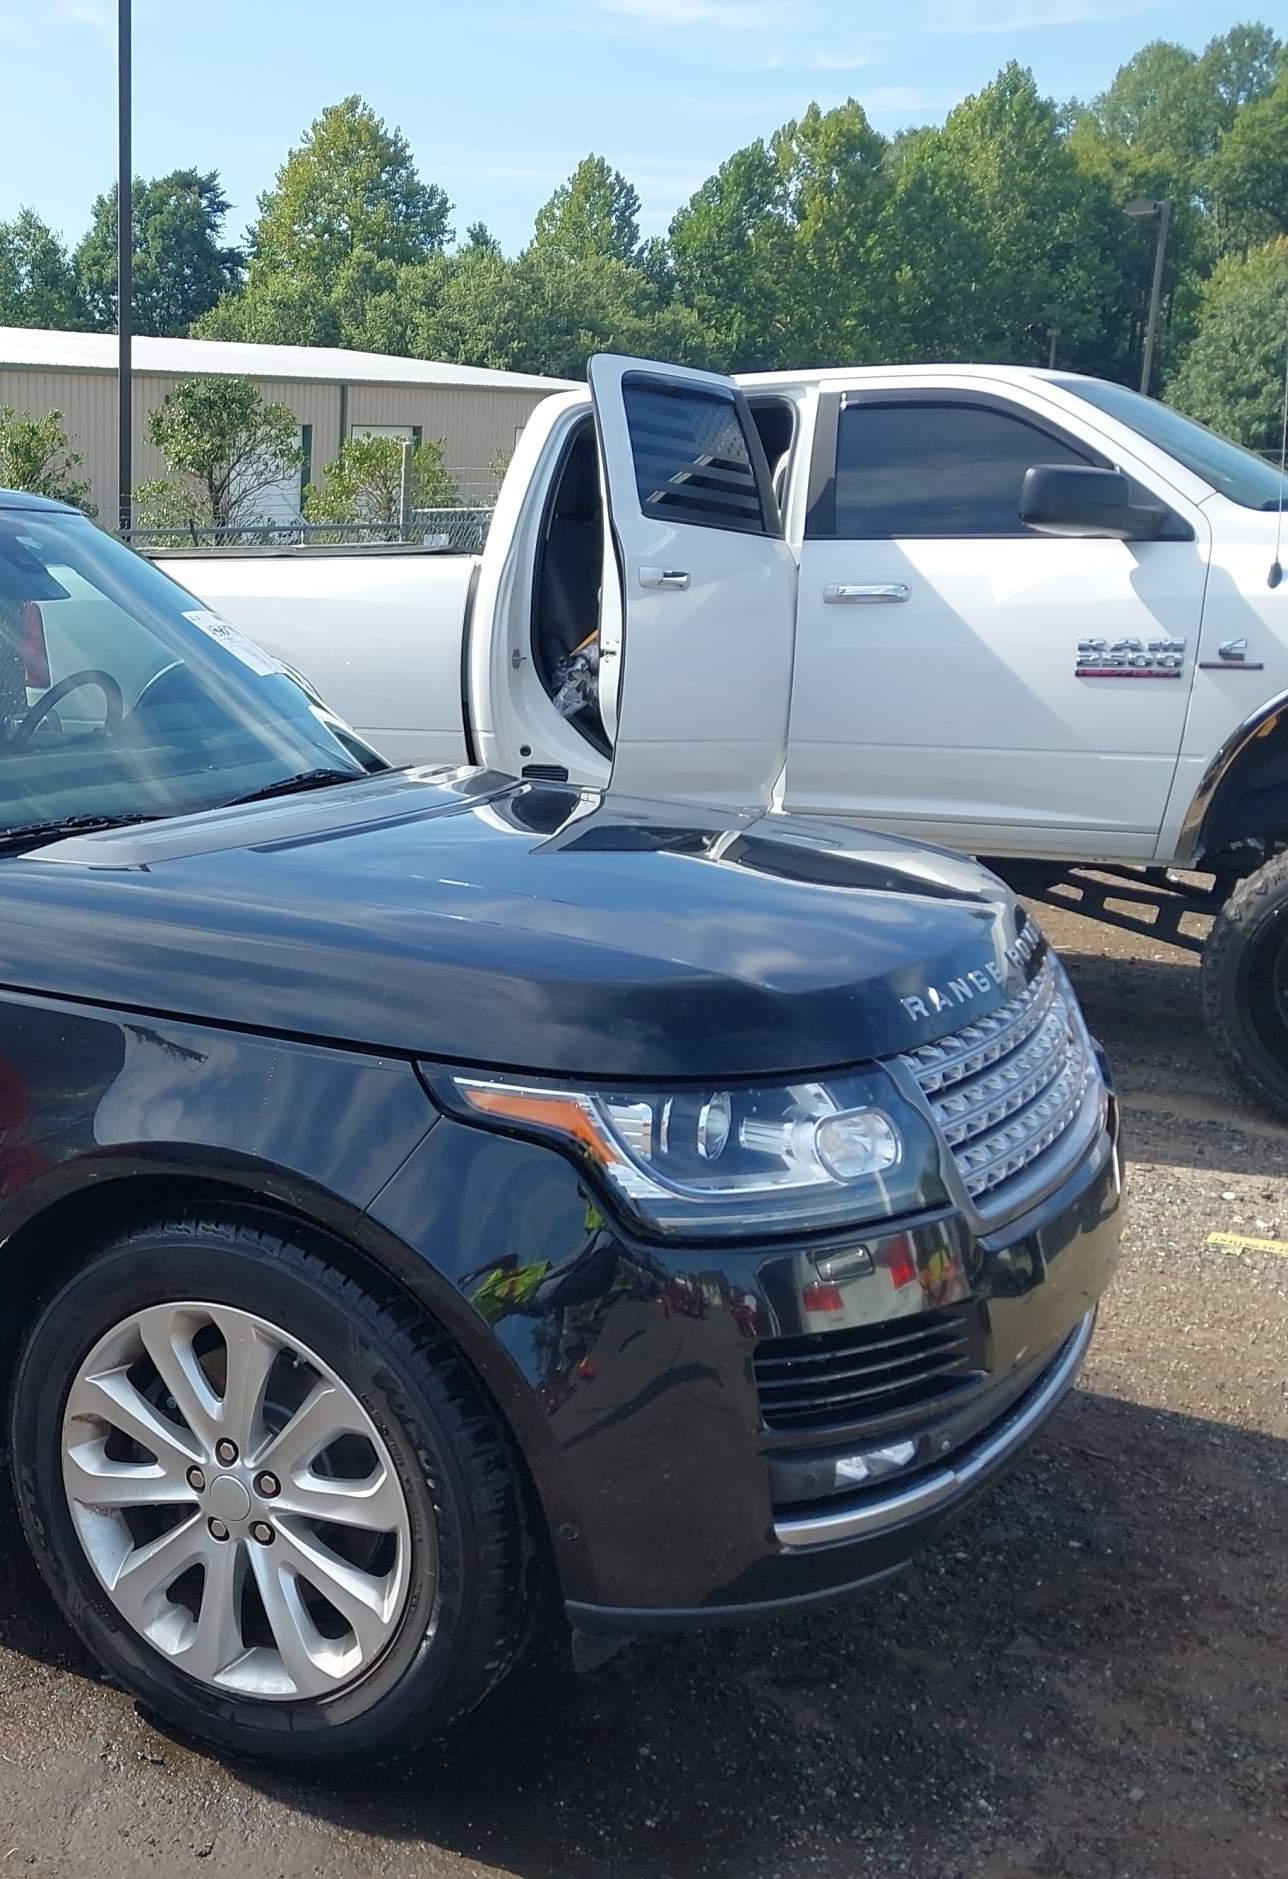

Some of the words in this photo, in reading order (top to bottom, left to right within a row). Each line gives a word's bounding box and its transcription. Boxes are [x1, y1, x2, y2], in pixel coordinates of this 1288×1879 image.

[1076, 652, 1183, 667] 2500
[900, 960, 1002, 1021] RANGE
[1005, 914, 1040, 968] ROV
